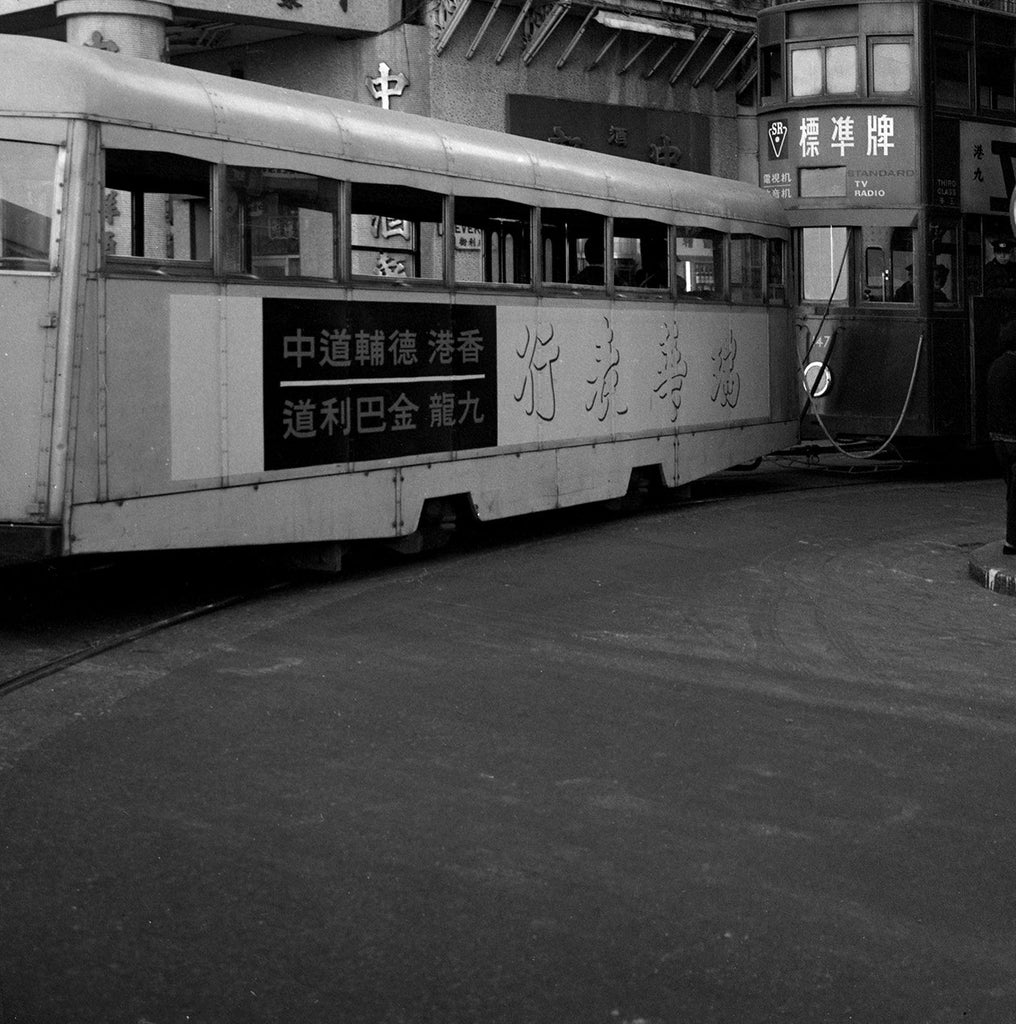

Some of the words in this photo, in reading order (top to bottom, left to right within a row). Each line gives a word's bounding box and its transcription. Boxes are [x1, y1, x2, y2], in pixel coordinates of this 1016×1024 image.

[799, 114, 895, 158] 標準牌
[854, 189, 886, 197] RADIO
